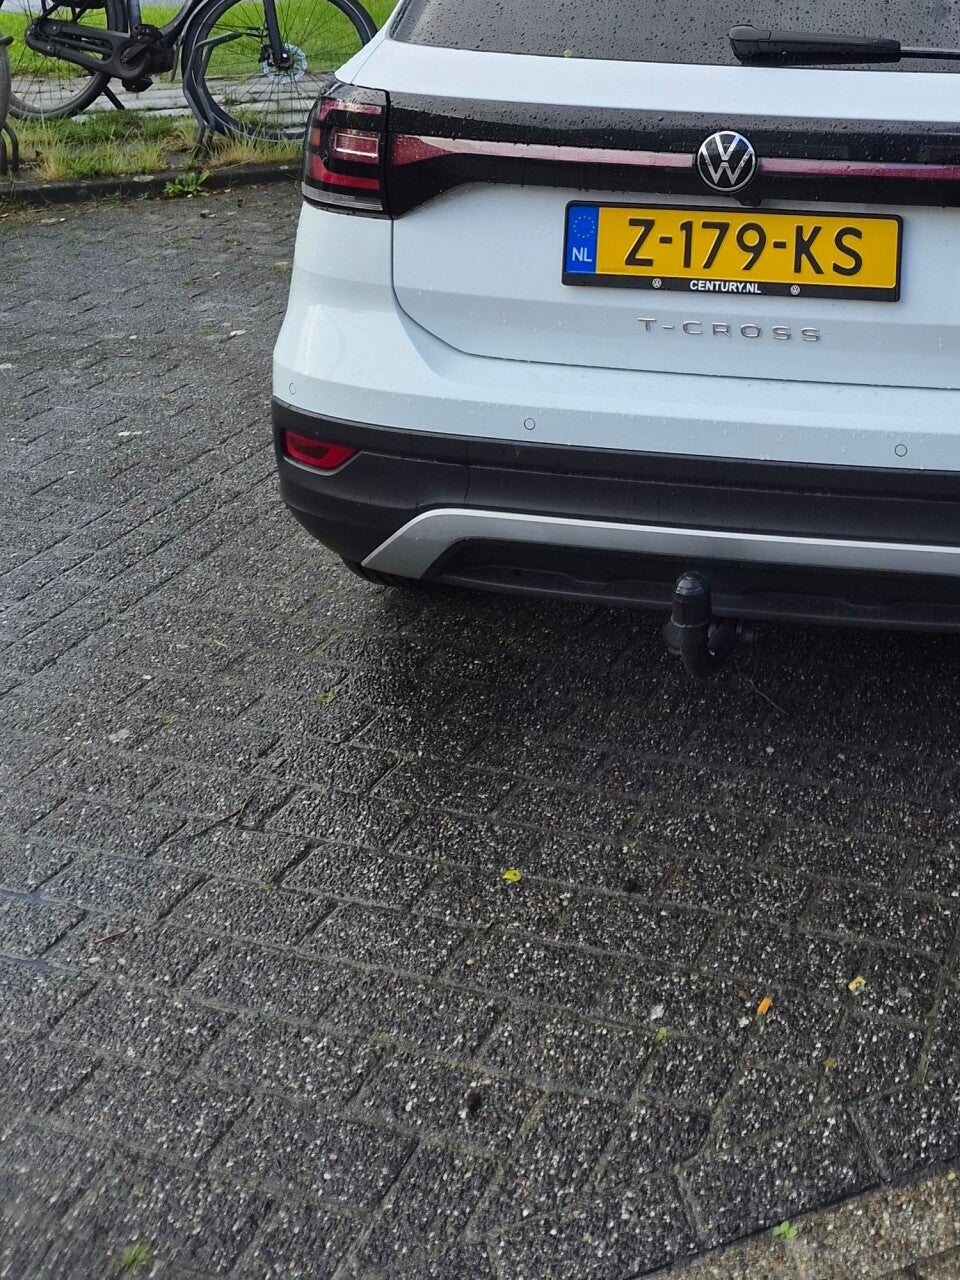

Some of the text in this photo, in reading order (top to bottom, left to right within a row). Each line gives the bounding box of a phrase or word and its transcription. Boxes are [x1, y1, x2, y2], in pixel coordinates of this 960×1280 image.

[571, 246, 593, 264] NL
[624, 217, 863, 276] Z-179-KS
[689, 279, 762, 295] CENTURY.NL
[637, 317, 821, 342] T-CROSS
